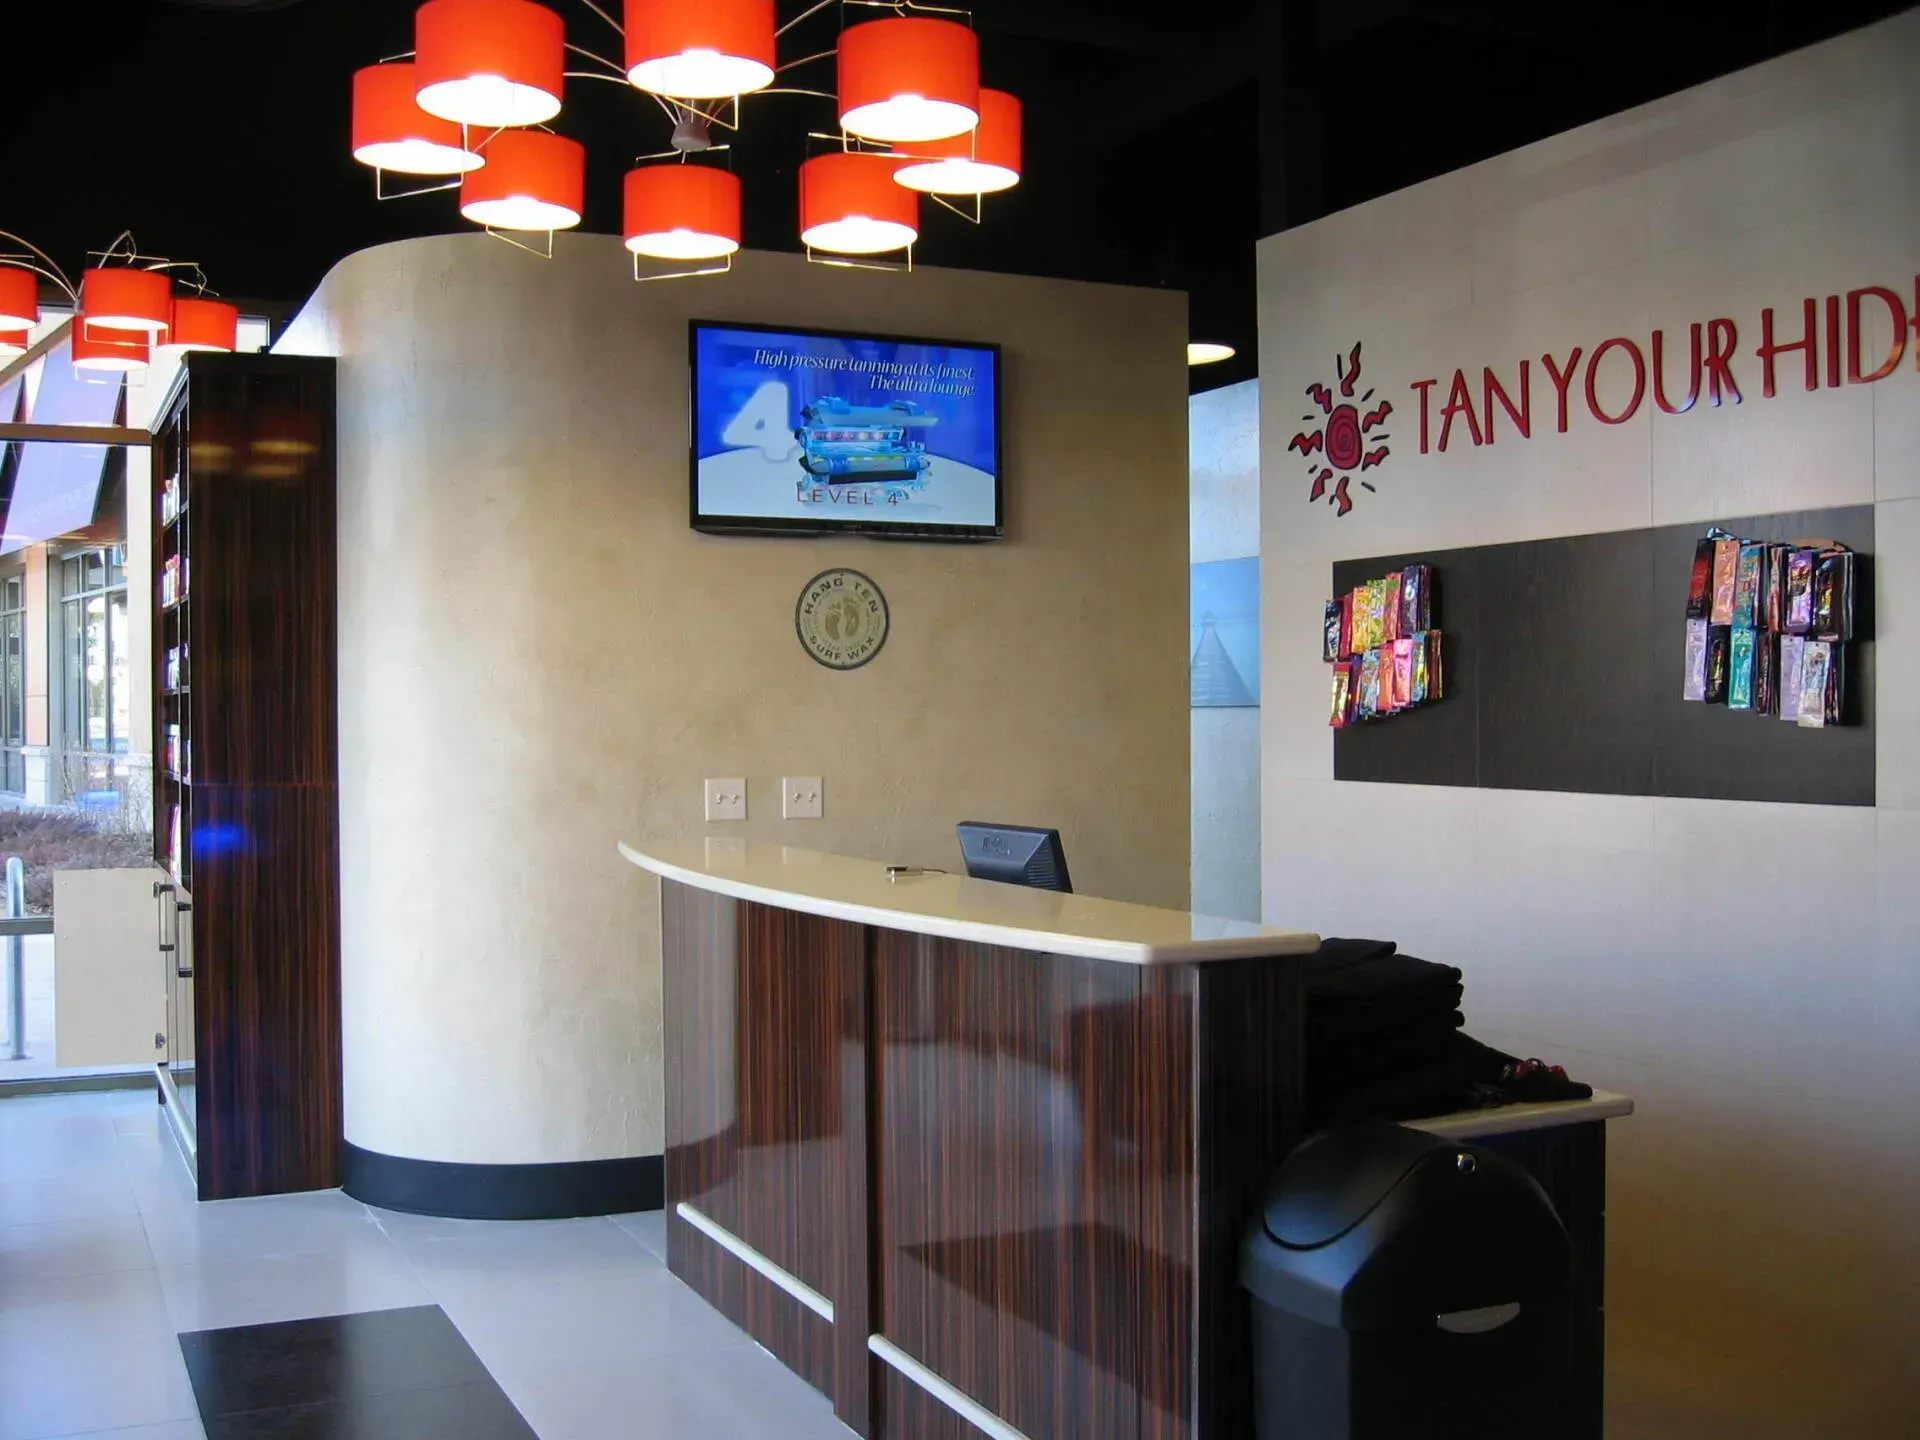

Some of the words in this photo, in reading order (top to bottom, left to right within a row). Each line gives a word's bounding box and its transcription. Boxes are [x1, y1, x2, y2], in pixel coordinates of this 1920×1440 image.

[753, 349, 787, 369] High
[789, 354, 847, 371] pressure
[848, 357, 903, 377] tanning
[904, 362, 918, 376] at
[919, 363, 935, 377] its
[1410, 359, 1530, 455] TAN
[1541, 317, 1743, 435] YOUR
[1756, 274, 1920, 398] HID
[869, 374, 893, 391] The
[895, 376, 929, 393] ultra
[796, 487, 874, 505] LEVEL
[887, 491, 898, 506] 4
[805, 577, 843, 615] HANG
[853, 581, 879, 613] TEN
[809, 635, 842, 661] SURF
[847, 635, 875, 661] WAX
